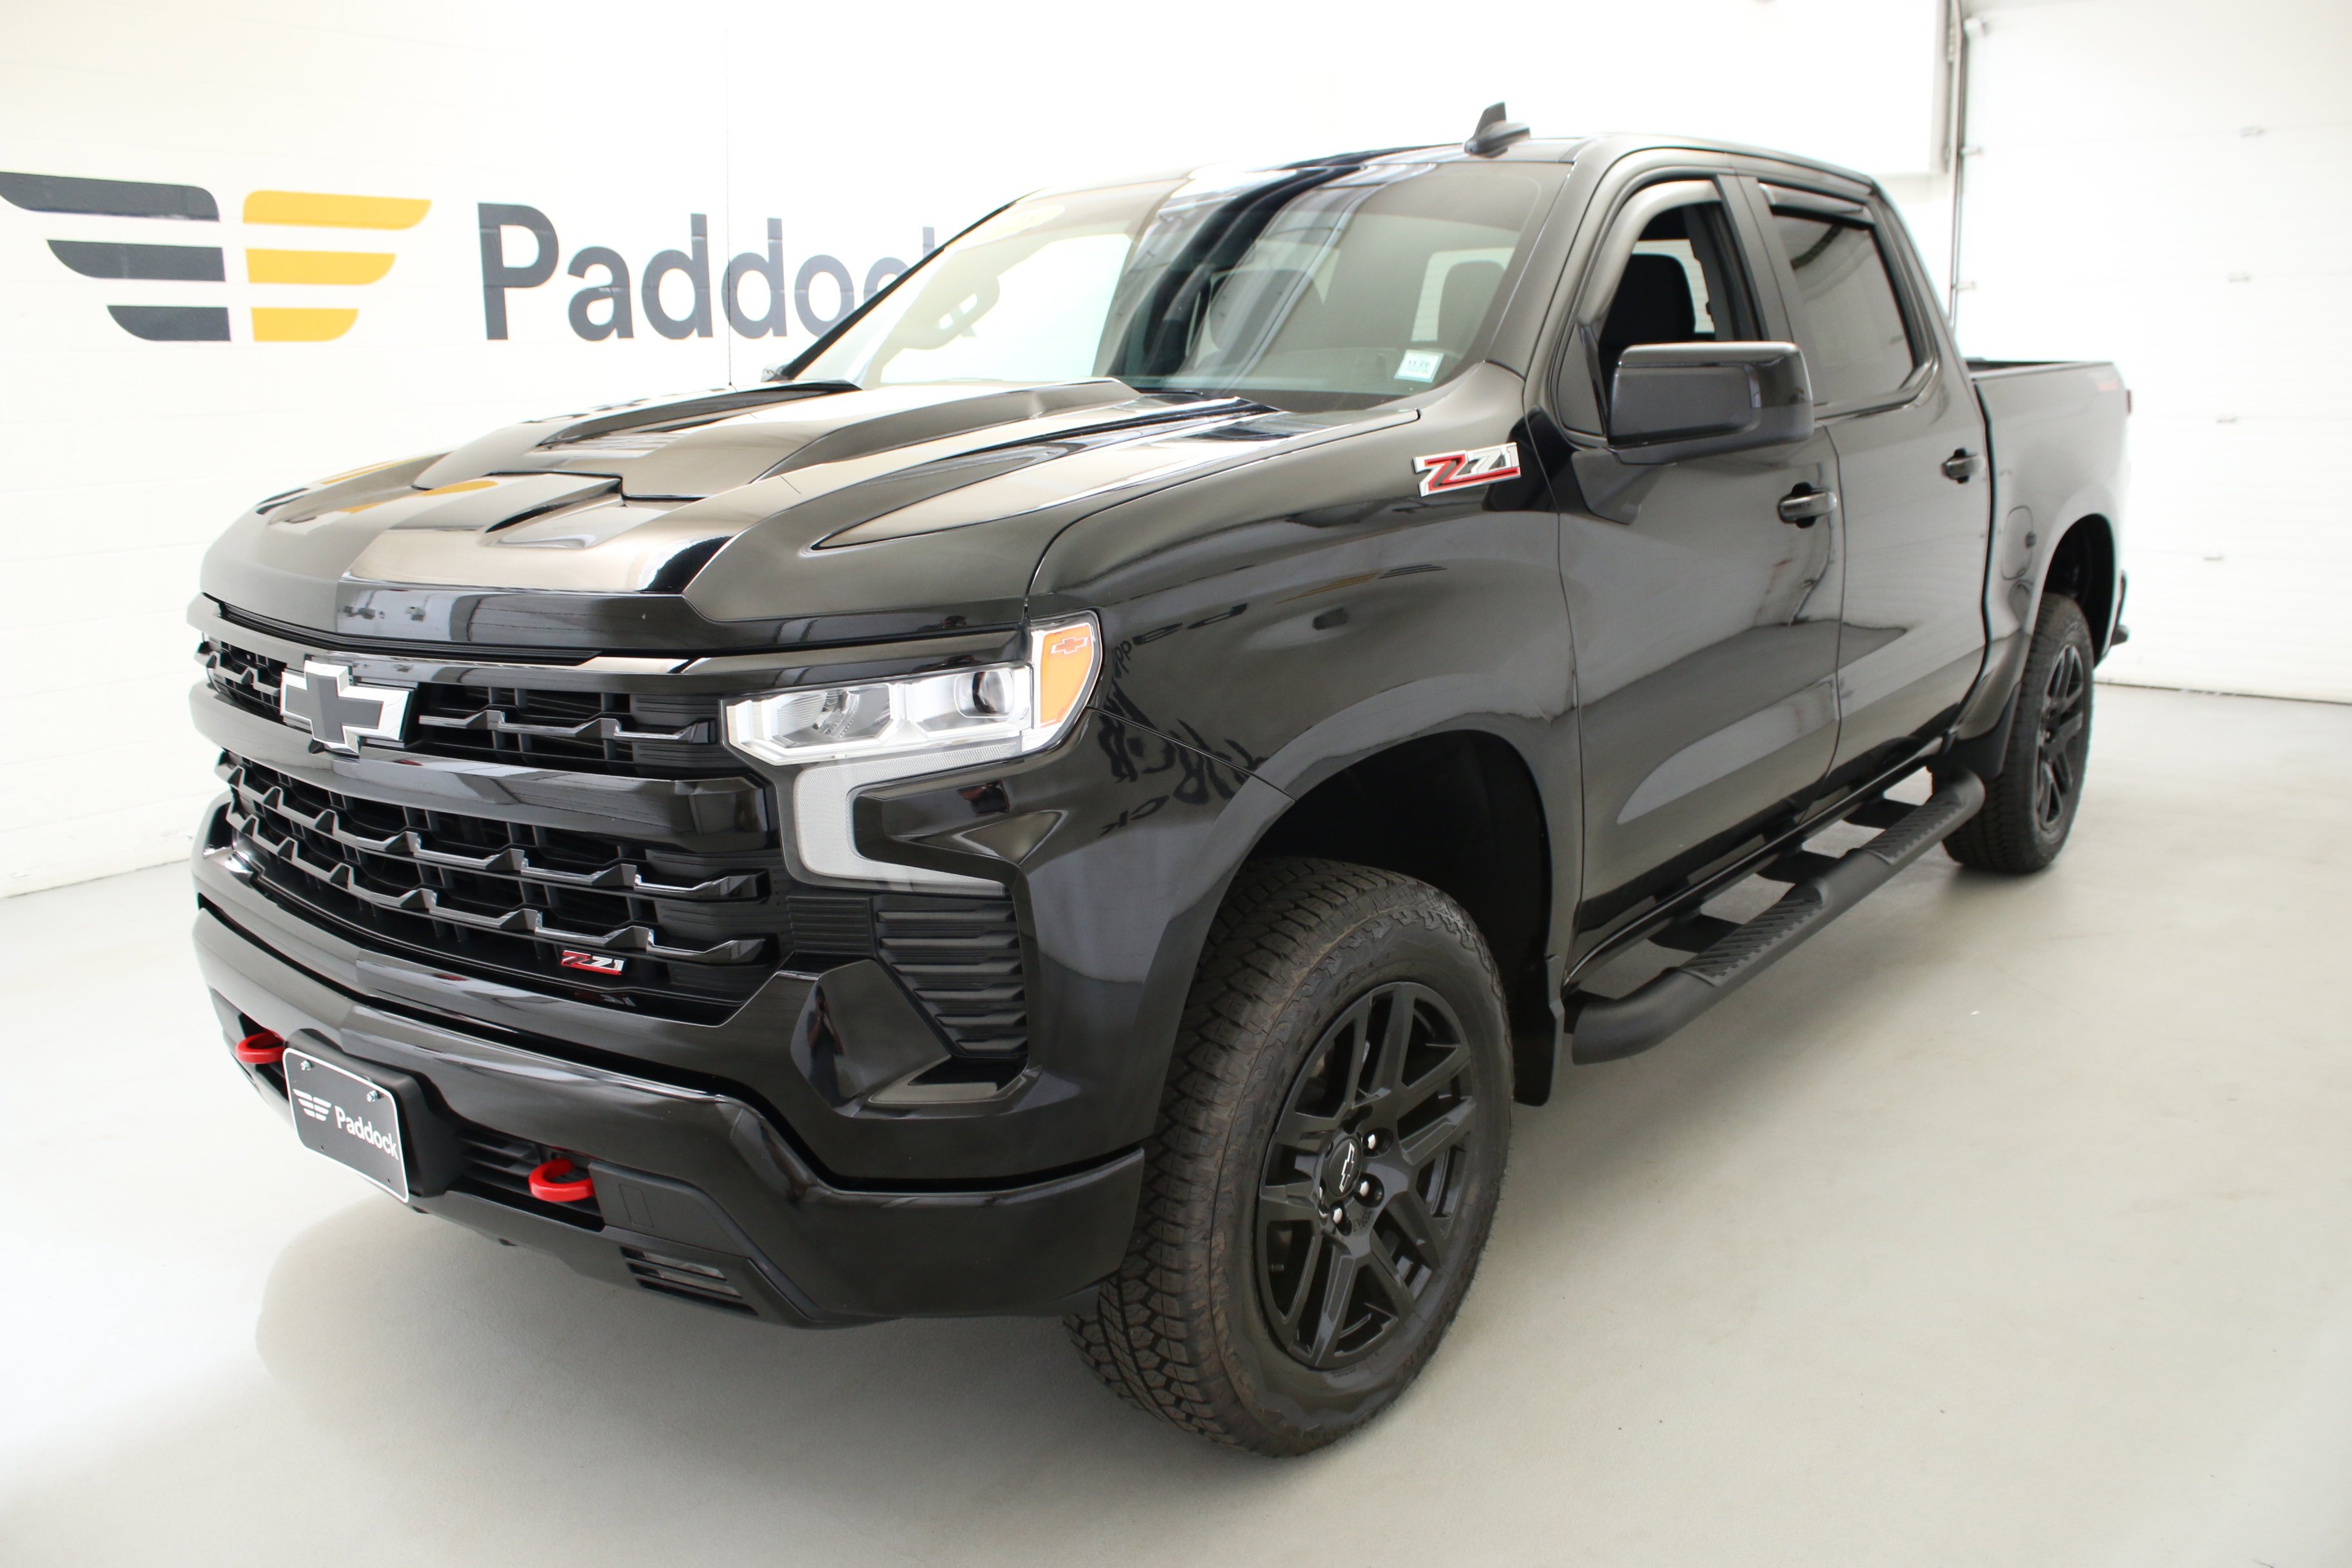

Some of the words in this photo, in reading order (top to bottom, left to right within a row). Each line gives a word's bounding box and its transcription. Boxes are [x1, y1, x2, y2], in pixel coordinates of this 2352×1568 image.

[1413, 442, 1521, 496] Z71
[561, 950, 624, 975] Z71
[335, 1105, 398, 1161] Paddock
